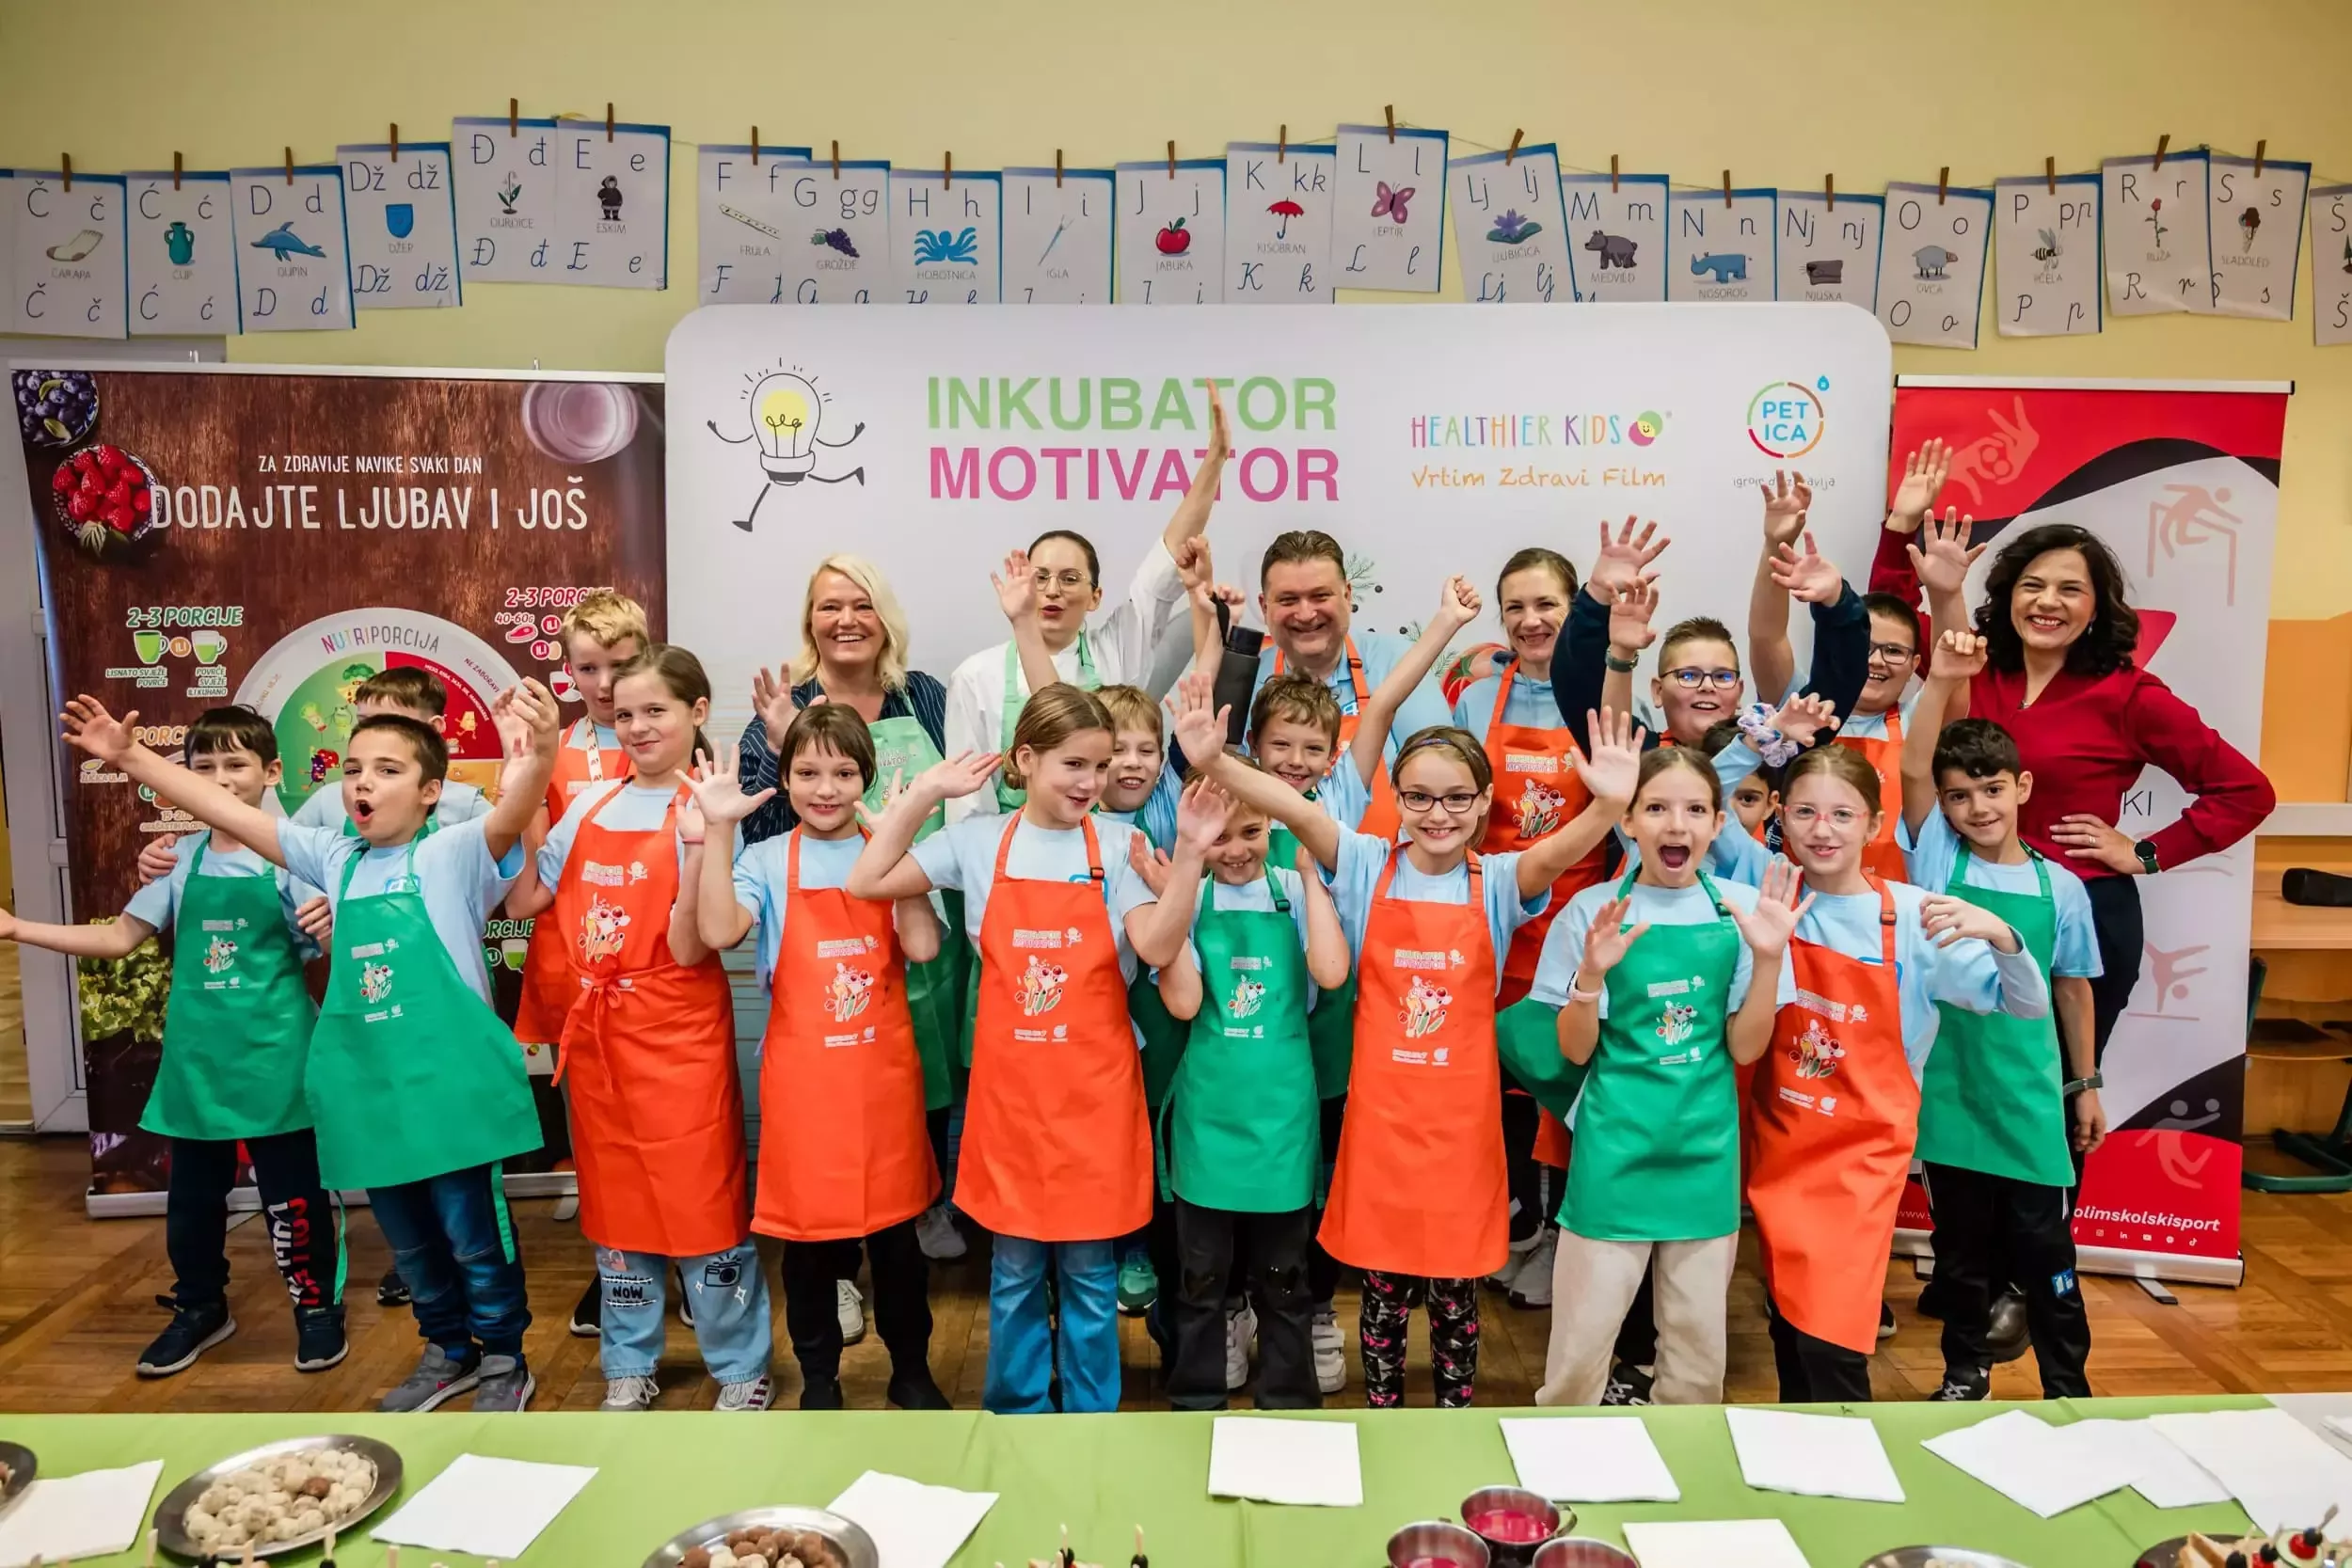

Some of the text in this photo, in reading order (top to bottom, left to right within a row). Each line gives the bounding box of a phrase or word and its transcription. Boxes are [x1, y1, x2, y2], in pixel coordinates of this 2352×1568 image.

[577, 139, 645, 172] E e
[1359, 143, 1371, 174] L
[349, 160, 440, 192] Dž dž
[719, 162, 733, 192] F
[1247, 160, 1265, 190] K
[2122, 174, 2186, 203] R r
[2217, 174, 2234, 203] S
[27, 180, 105, 221] Č č
[139, 182, 214, 219] Ć ć
[250, 183, 324, 215] D d
[794, 178, 817, 207] G
[909, 188, 980, 217] H h
[1468, 174, 1489, 211] Lj
[1570, 191, 1654, 221] M m
[1683, 208, 1756, 237] N n
[1899, 200, 1968, 234] O o
[2014, 195, 2029, 224] P
[2330, 196, 2346, 232] Š
[1787, 207, 1865, 249] Nj nj
[567, 242, 642, 274] E e
[1155, 261, 1193, 273] JABUKA
[916, 270, 977, 280] HOBOTNICA
[1238, 262, 1315, 292] K k
[2123, 273, 2146, 300] R
[26, 282, 102, 322] Č č
[140, 284, 214, 321] Ć ć
[253, 286, 328, 316] D d
[1698, 288, 1748, 300] NOSOROG
[1891, 300, 1911, 326] O
[2333, 293, 2349, 329] Š
[928, 376, 1337, 432] INKUBATOR
[1763, 402, 1809, 419] PET
[1411, 414, 1622, 449] HEALTHIER KIDS
[1765, 423, 1807, 441] ICA
[259, 456, 483, 474] ZA ZDRAVIJE NAVIKE SVAKI DAN
[1412, 465, 1666, 489] Vrtim Zdravi Film
[151, 476, 588, 531] DODAJTE LJUBAV I JOŠ
[505, 587, 613, 607] 2-3 PORC
[128, 607, 243, 626] 2-3 PORCIJE
[321, 626, 440, 654] NUTRIPORCIJA
[106, 668, 138, 677] LISNATO
[612, 1286, 643, 1299] NOW
